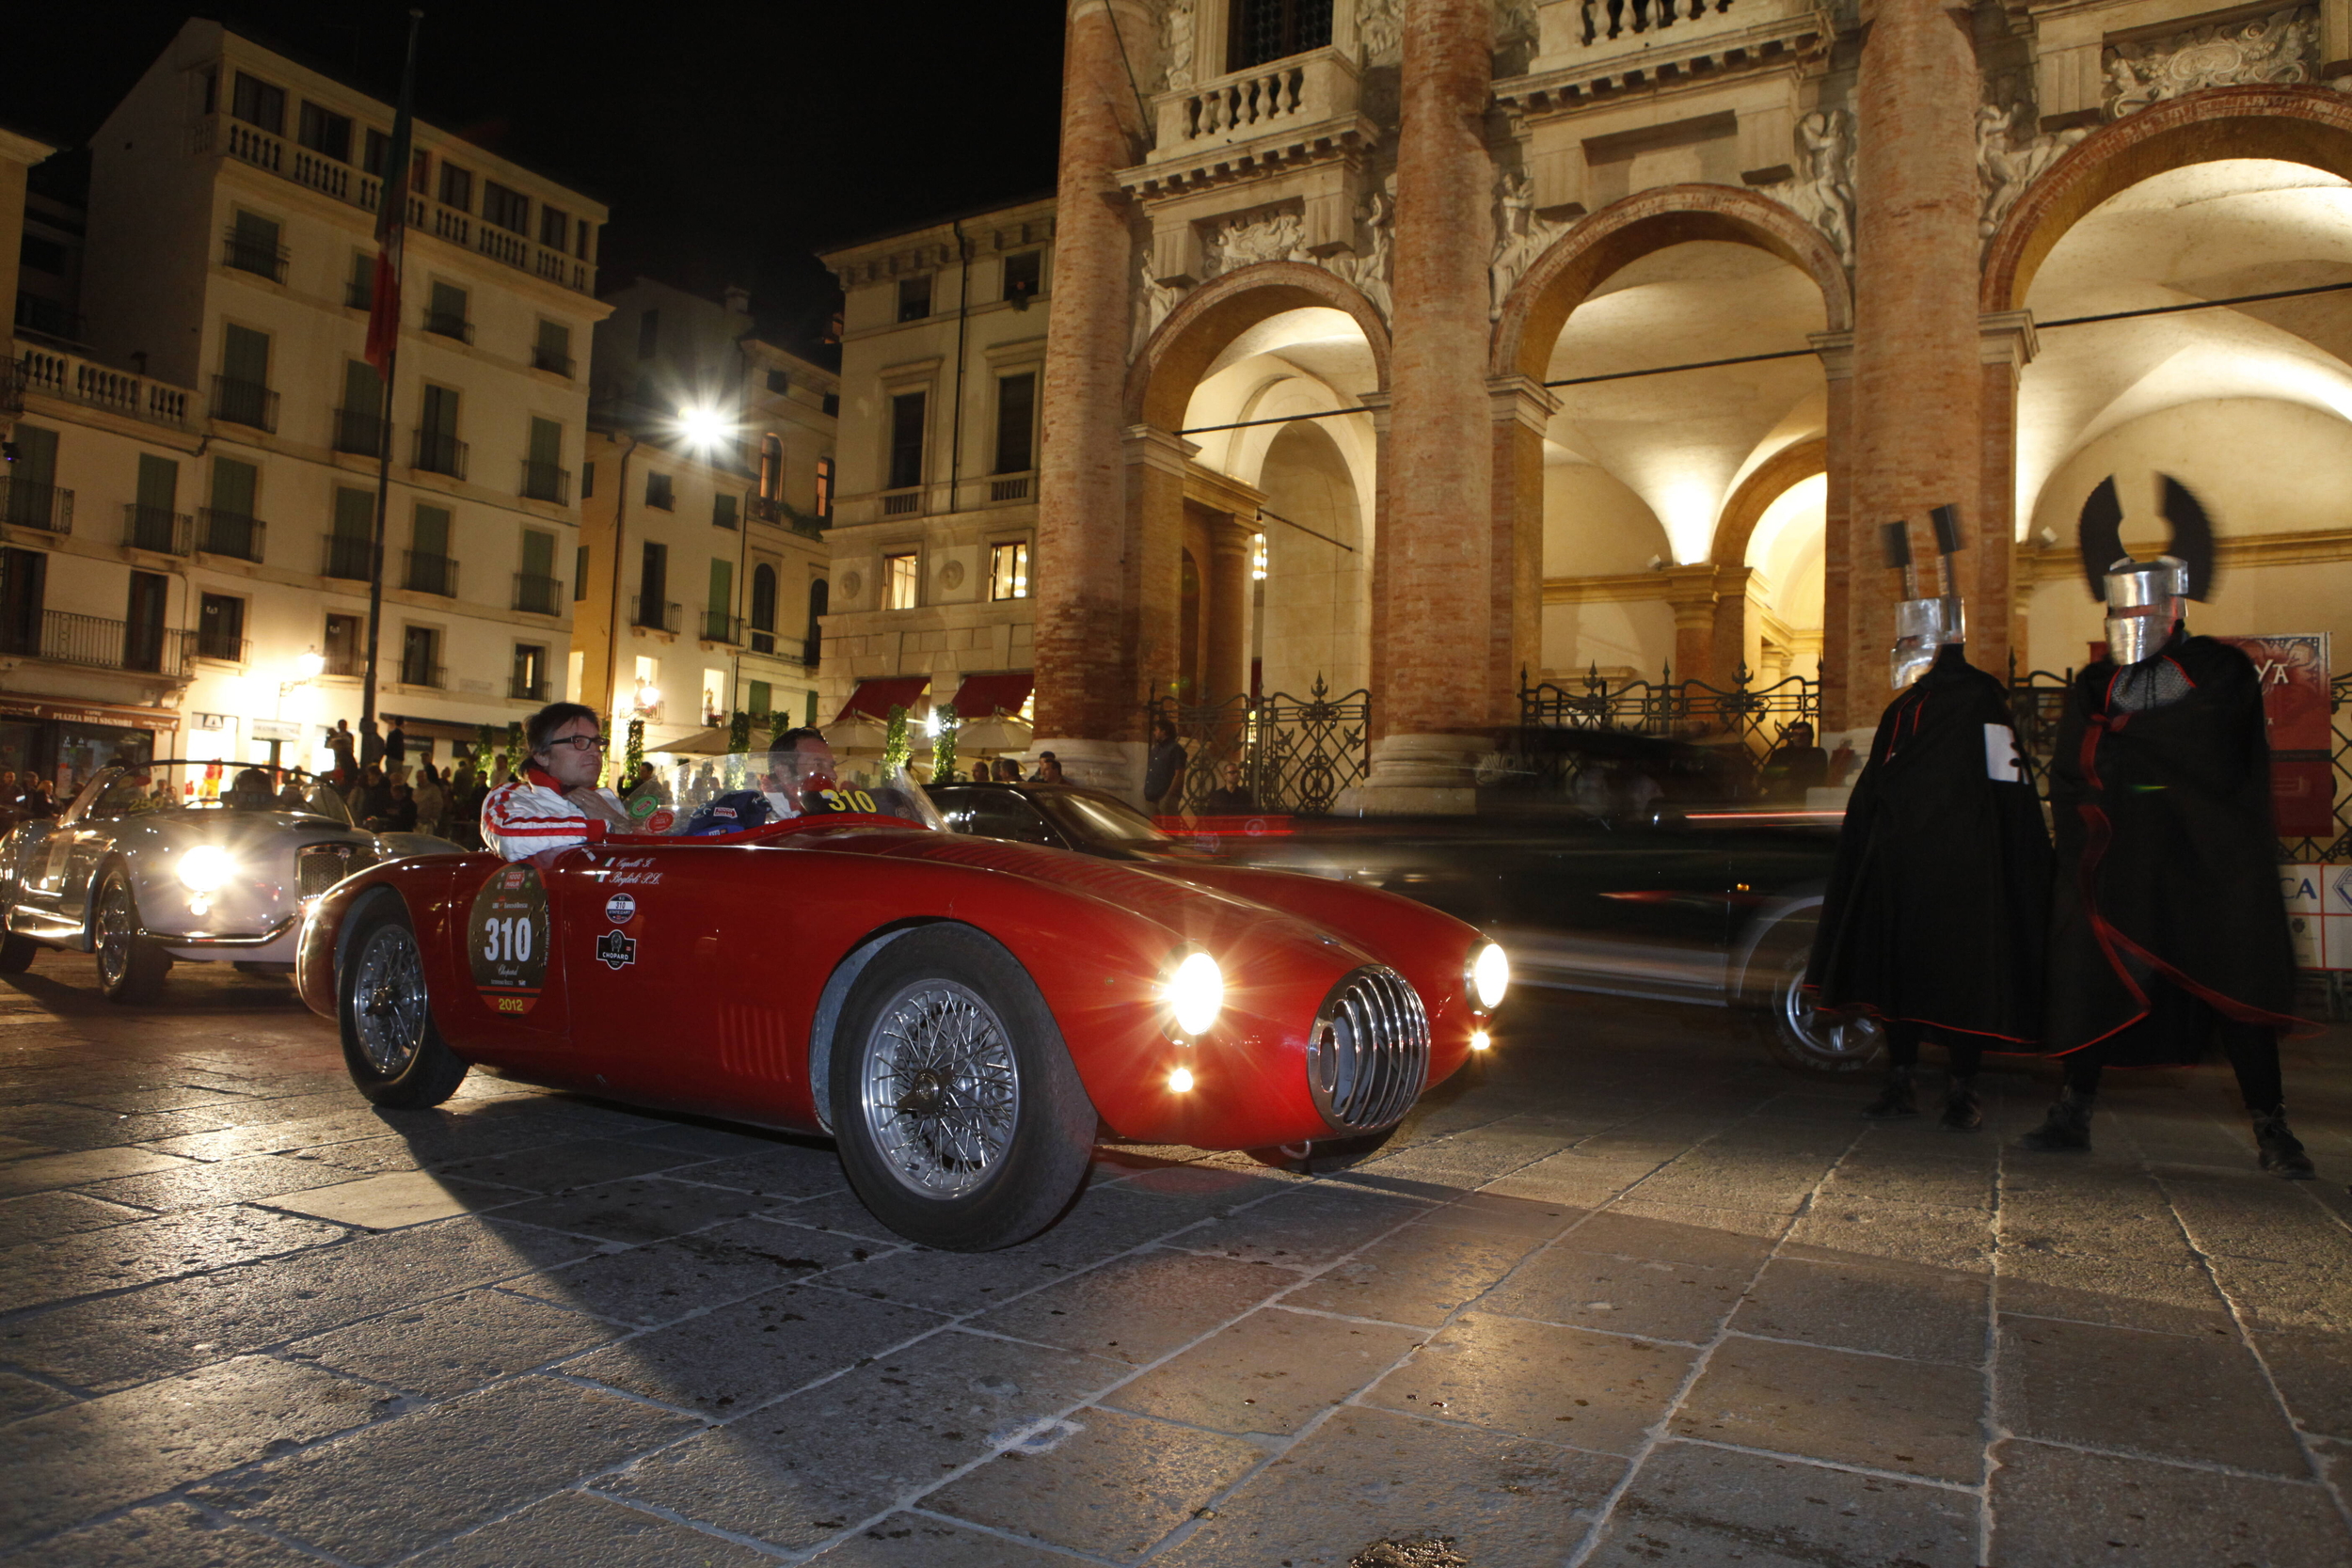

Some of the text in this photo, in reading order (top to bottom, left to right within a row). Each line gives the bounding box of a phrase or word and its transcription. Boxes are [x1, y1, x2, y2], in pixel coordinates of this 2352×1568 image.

[2254, 659, 2288, 684] YA
[54, 712, 133, 727] PIAZZA DEI SIGNORI
[821, 789, 877, 813] 310
[2280, 878, 2317, 899] CA
[484, 917, 532, 962] 310
[602, 951, 629, 960] CHOPARD
[497, 964, 519, 977] Chopard
[499, 998, 524, 1011] 2012
